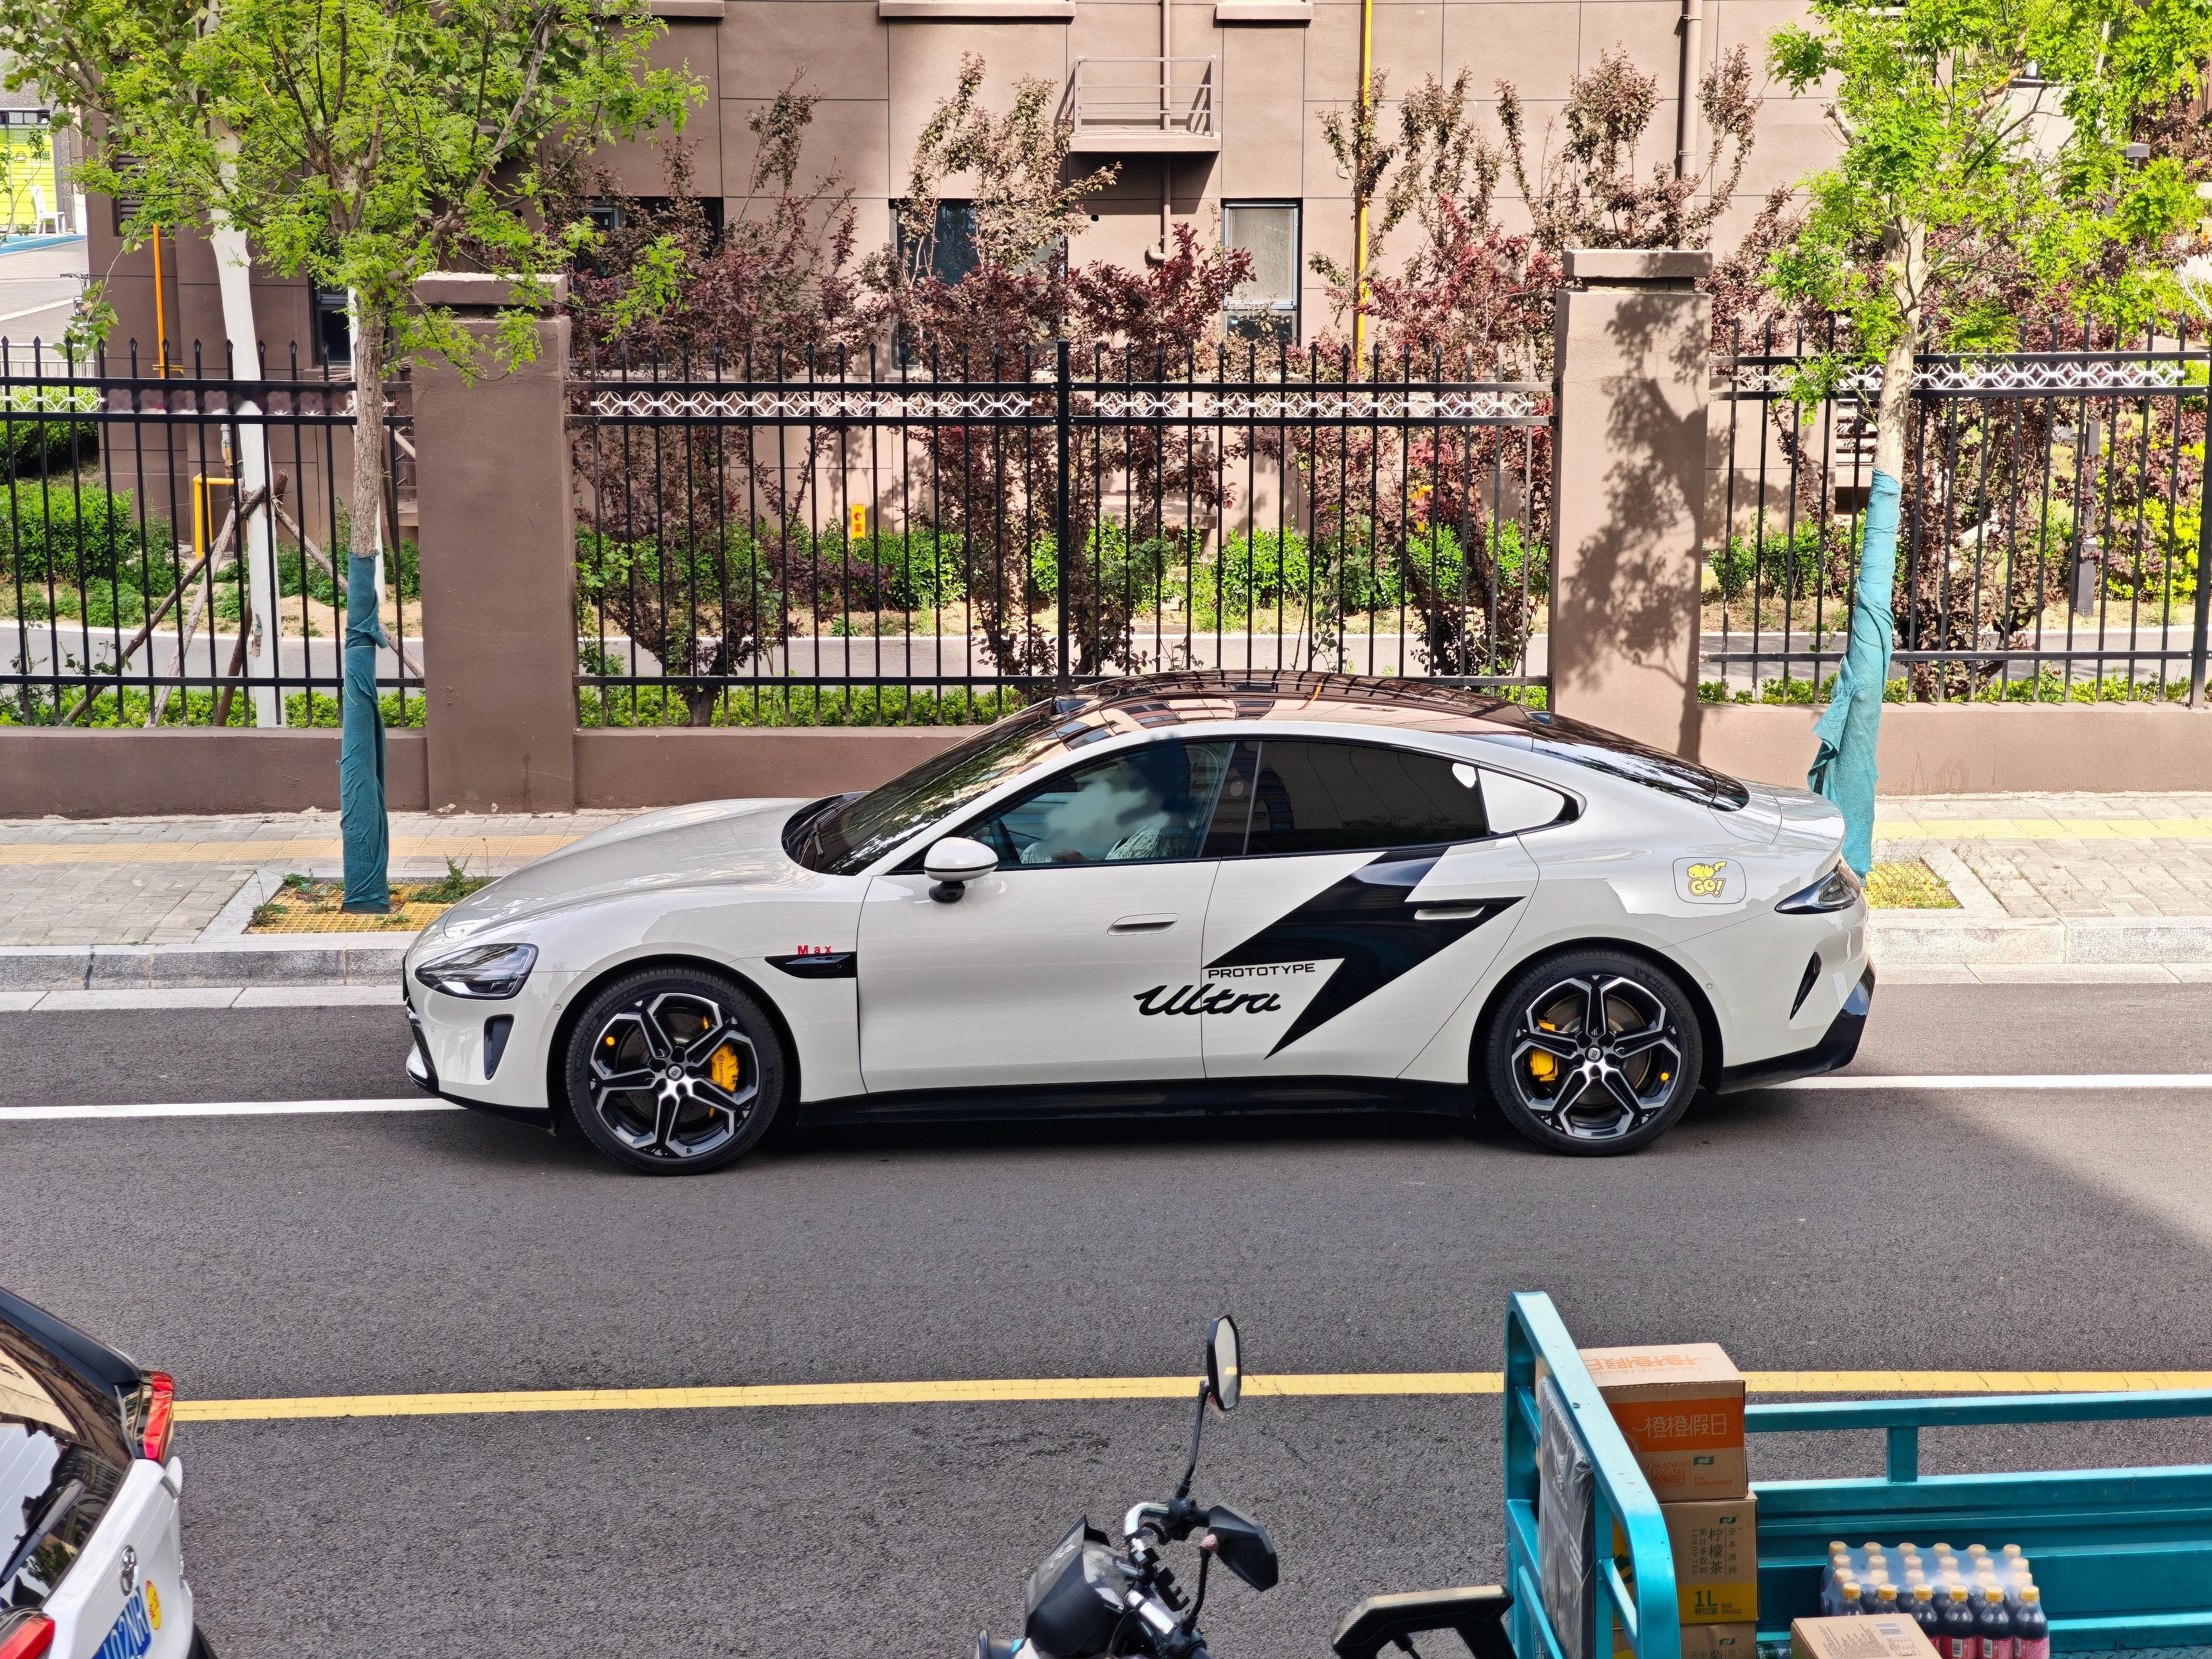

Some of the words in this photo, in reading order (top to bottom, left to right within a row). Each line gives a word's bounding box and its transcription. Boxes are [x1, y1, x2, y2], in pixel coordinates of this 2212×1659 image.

[1688, 878, 1727, 898] GO!
[798, 945, 832, 955] Max
[1208, 963, 1316, 979] PROTOTYPE
[1133, 983, 1282, 1016] Ultra
[1645, 975, 1686, 1019] MICHELIN
[575, 1017, 599, 1068] MICHELIN
[1633, 1413, 1727, 1438] 橙橙假日
[1709, 1527, 1724, 1574] 柠檬茶
[1695, 1590, 1718, 1607] 1L
